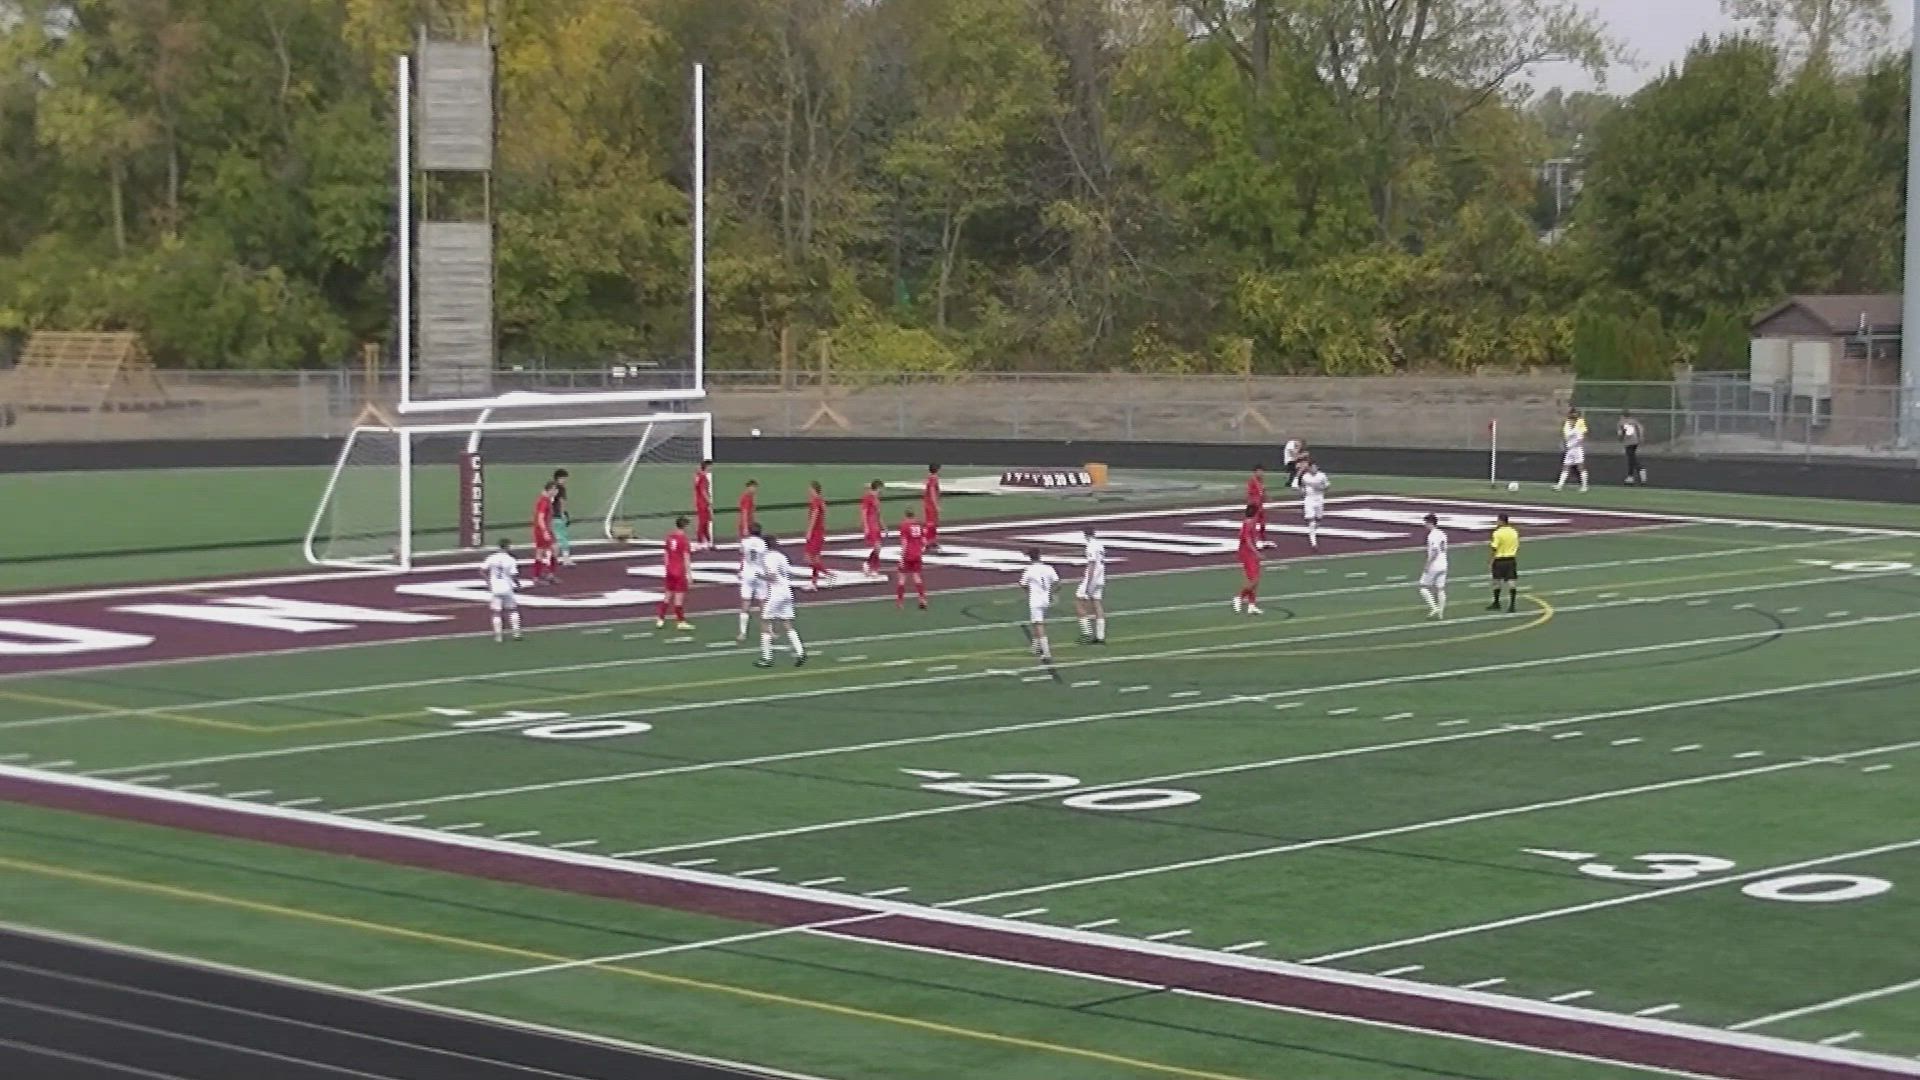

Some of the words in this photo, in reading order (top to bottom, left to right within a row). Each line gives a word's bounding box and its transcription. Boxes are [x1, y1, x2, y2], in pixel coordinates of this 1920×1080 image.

[471, 456, 483, 546] CADETS
[452, 711, 653, 739] 10
[919, 773, 1202, 809] 20
[1578, 853, 1893, 901] 30
